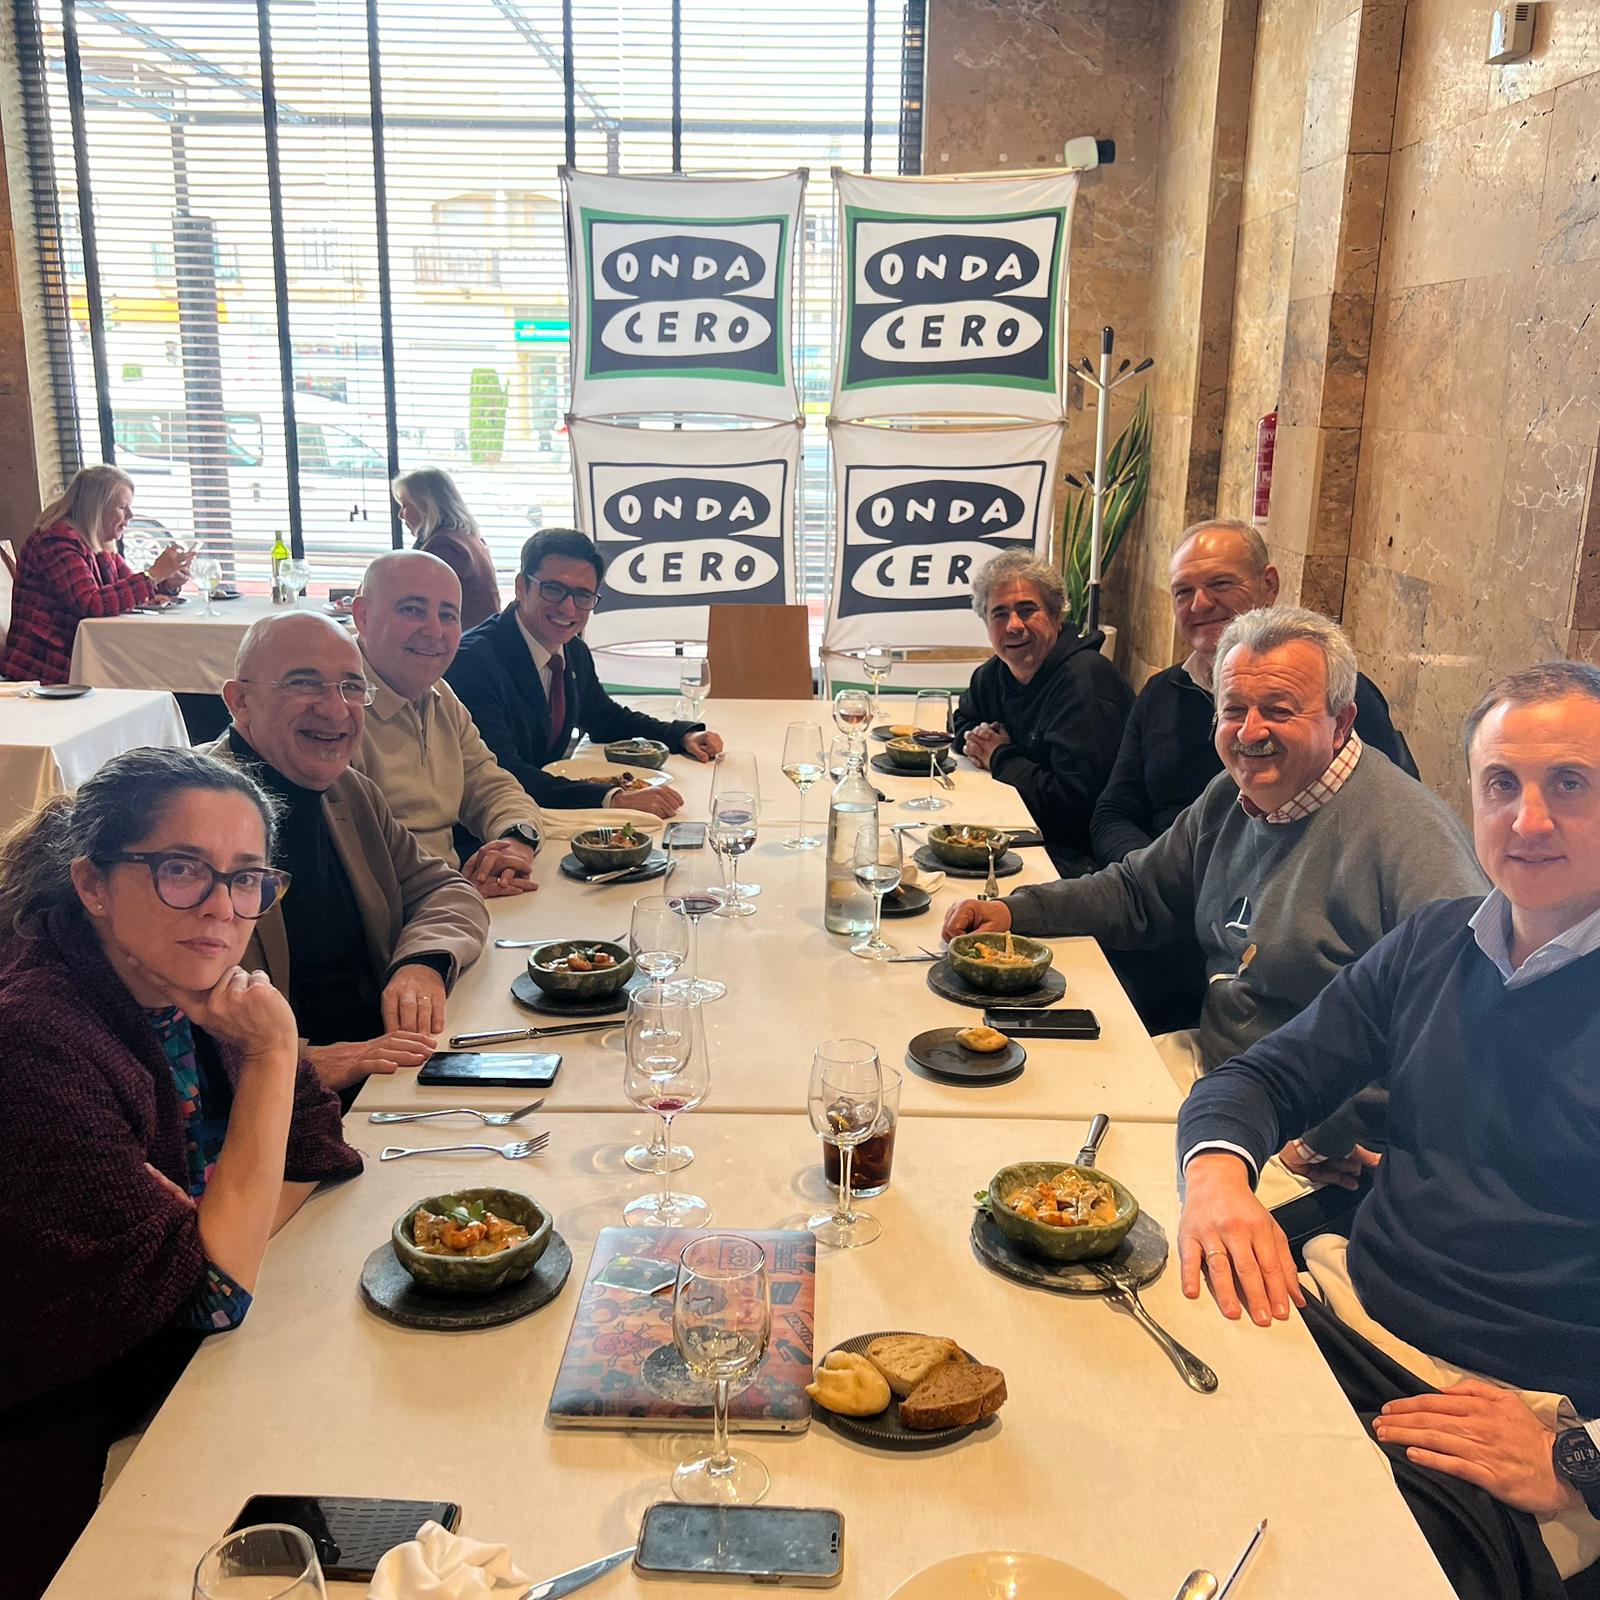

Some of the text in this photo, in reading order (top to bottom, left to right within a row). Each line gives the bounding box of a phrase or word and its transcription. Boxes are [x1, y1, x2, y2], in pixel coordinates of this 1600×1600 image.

[616, 252, 750, 283] ONDA
[880, 253, 1023, 285] ONDA
[624, 311, 750, 344] CERO
[886, 314, 1020, 350] CERO
[618, 494, 756, 525] ONDA
[871, 497, 1008, 527] ONDA
[628, 551, 756, 584] CERO
[876, 554, 973, 587] CER
